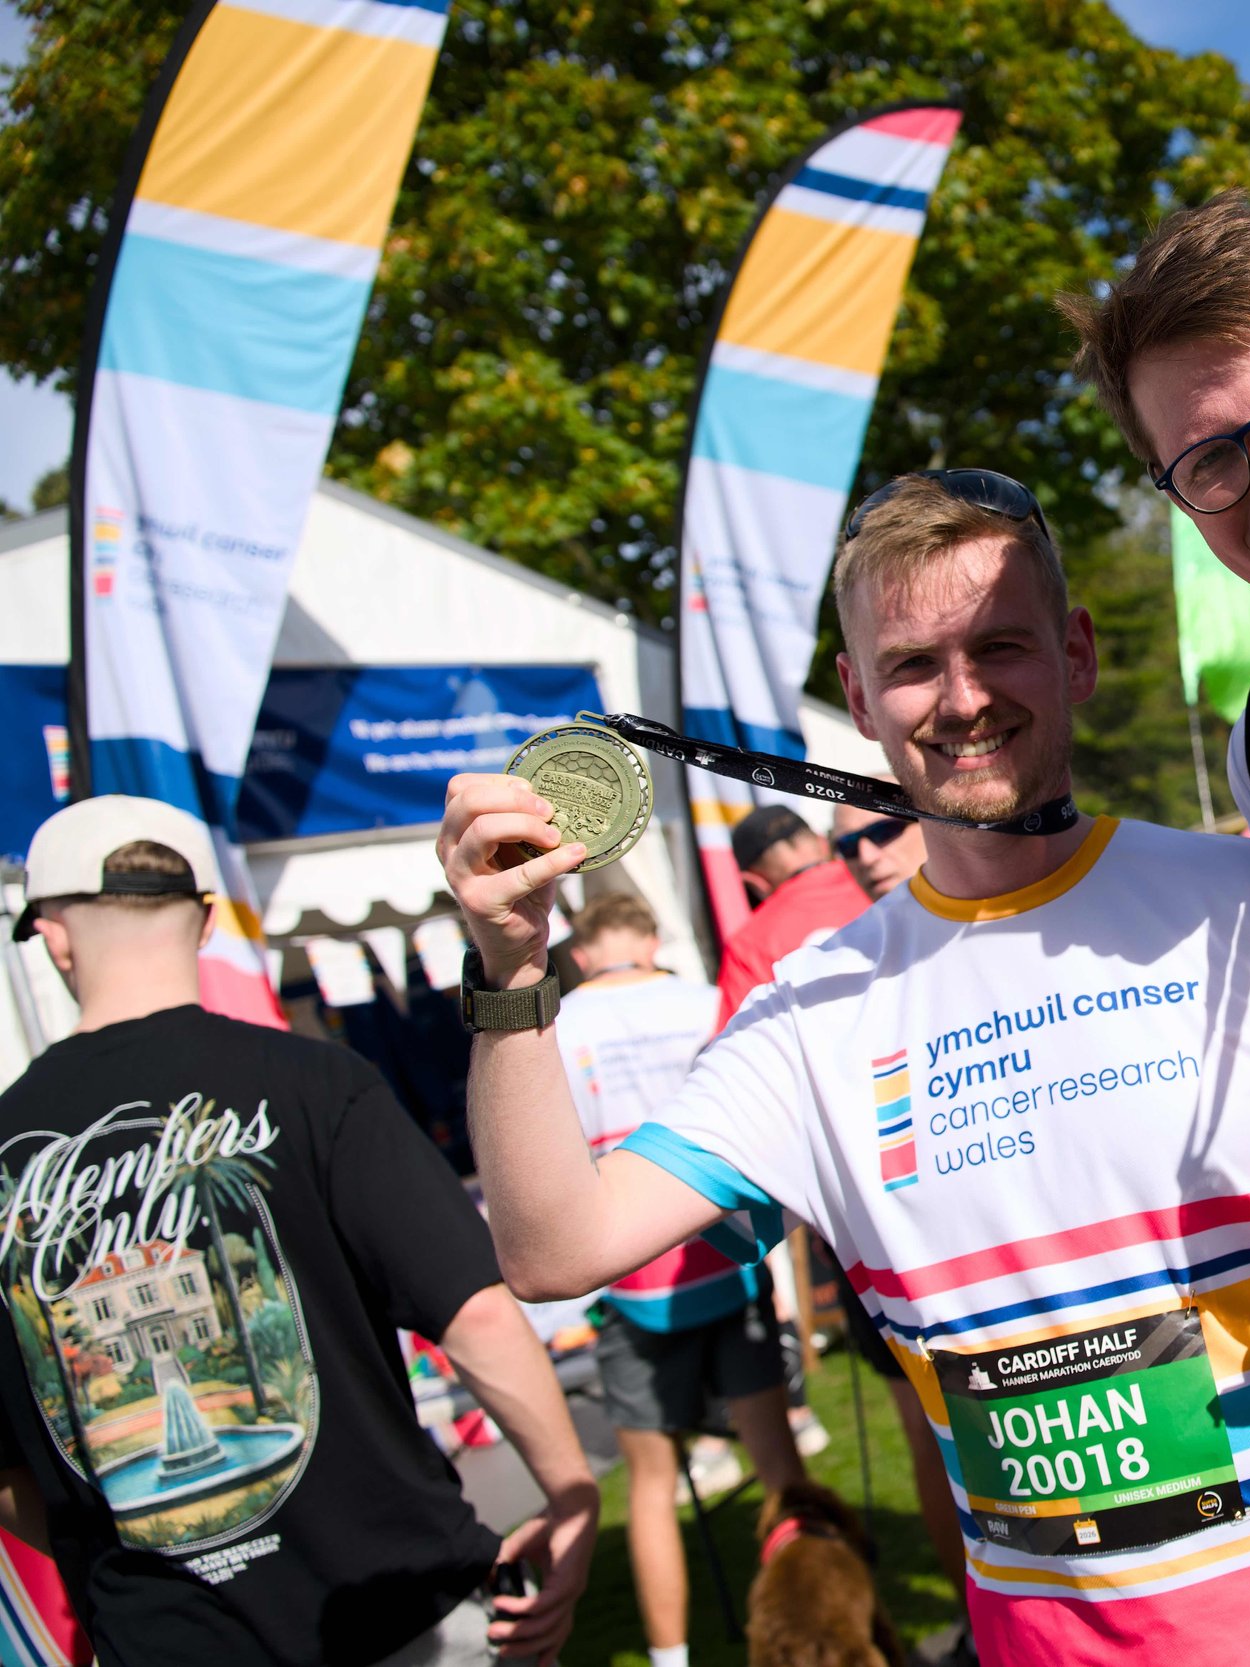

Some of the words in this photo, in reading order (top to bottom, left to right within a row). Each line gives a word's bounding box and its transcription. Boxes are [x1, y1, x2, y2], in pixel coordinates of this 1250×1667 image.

[805, 783, 846, 801] 2026
[926, 994, 1067, 1069] ymchwil
[1072, 980, 1199, 1018] canser
[927, 1049, 1031, 1100] cymru
[930, 1085, 1043, 1136] cancer
[1048, 1050, 1200, 1106] research
[0, 1092, 280, 1258] Members
[934, 1130, 1036, 1175] wales
[997, 1341, 1080, 1375] CARDIFF
[1084, 1328, 1138, 1357] HALF
[1002, 1372, 1039, 1388] HANNER
[1040, 1361, 1092, 1381] MARATHON
[1092, 1350, 1142, 1369] CAERDYDD
[987, 1383, 1148, 1450] JOHAN
[1001, 1437, 1150, 1497] 20018
[1114, 1487, 1155, 1504] UNISEX
[1156, 1476, 1202, 1497] MEDIUM
[1079, 1530, 1097, 1540] 2026
